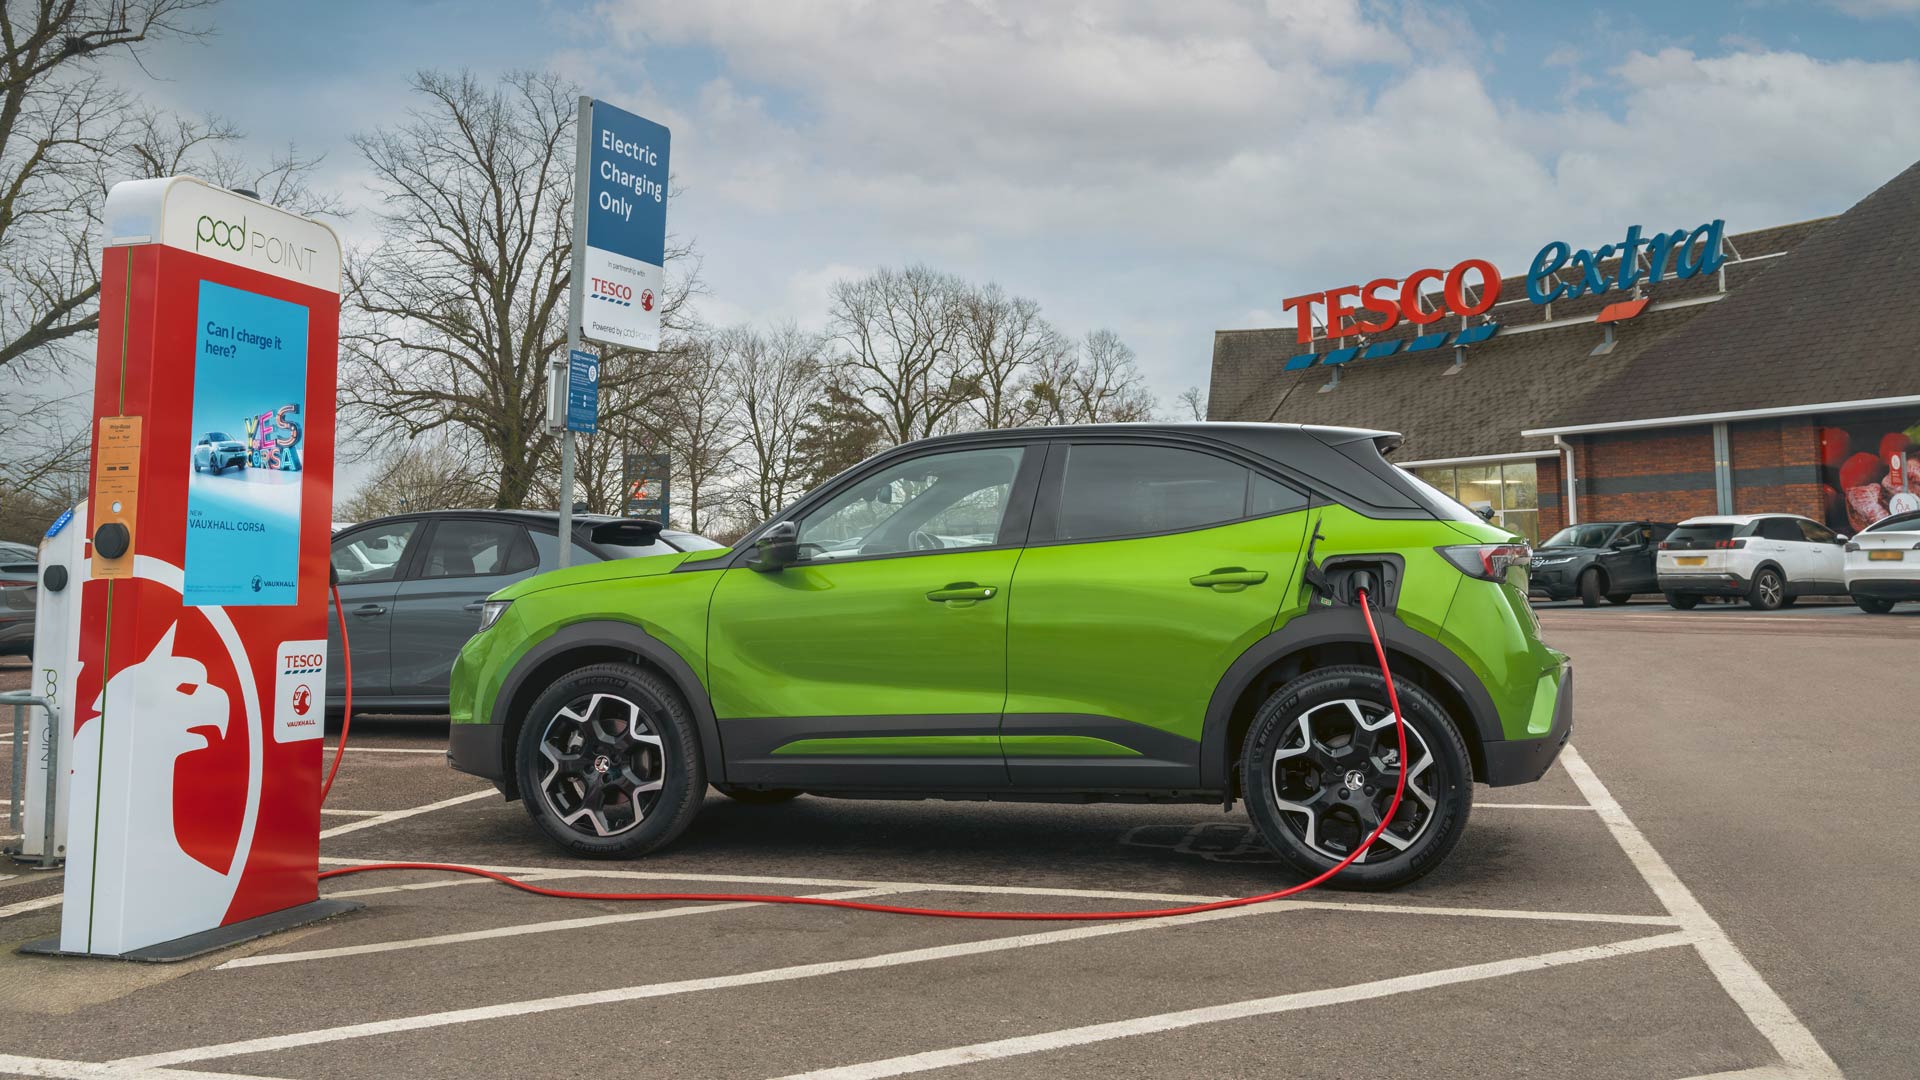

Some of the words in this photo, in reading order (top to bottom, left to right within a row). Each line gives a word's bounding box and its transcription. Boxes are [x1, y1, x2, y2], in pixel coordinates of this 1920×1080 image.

[602, 129, 657, 167] Electric
[600, 160, 662, 203] Charging
[599, 191, 632, 222] Only
[196, 215, 246, 252] pod
[250, 231, 317, 274] POINT
[612, 263, 637, 277] partnership
[1283, 259, 1501, 344] TESCO
[1526, 219, 1728, 306] extra
[591, 277, 632, 300] TESCO
[206, 321, 230, 339] Can
[231, 326, 235, 340] I
[236, 328, 273, 350] charge
[274, 336, 282, 350] it
[592, 321, 616, 335] Powered
[615, 328, 623, 338] by
[205, 340, 237, 359] here?
[244, 404, 302, 451] YES
[246, 447, 301, 472] CORSA
[189, 519, 235, 531] VAUXHALL
[236, 522, 266, 532] CORSA
[263, 580, 295, 588] VAUXHALL
[285, 654, 323, 668] TESCO
[287, 719, 316, 727] VAUXHALL
[1259, 695, 1298, 745] MICHELIN
